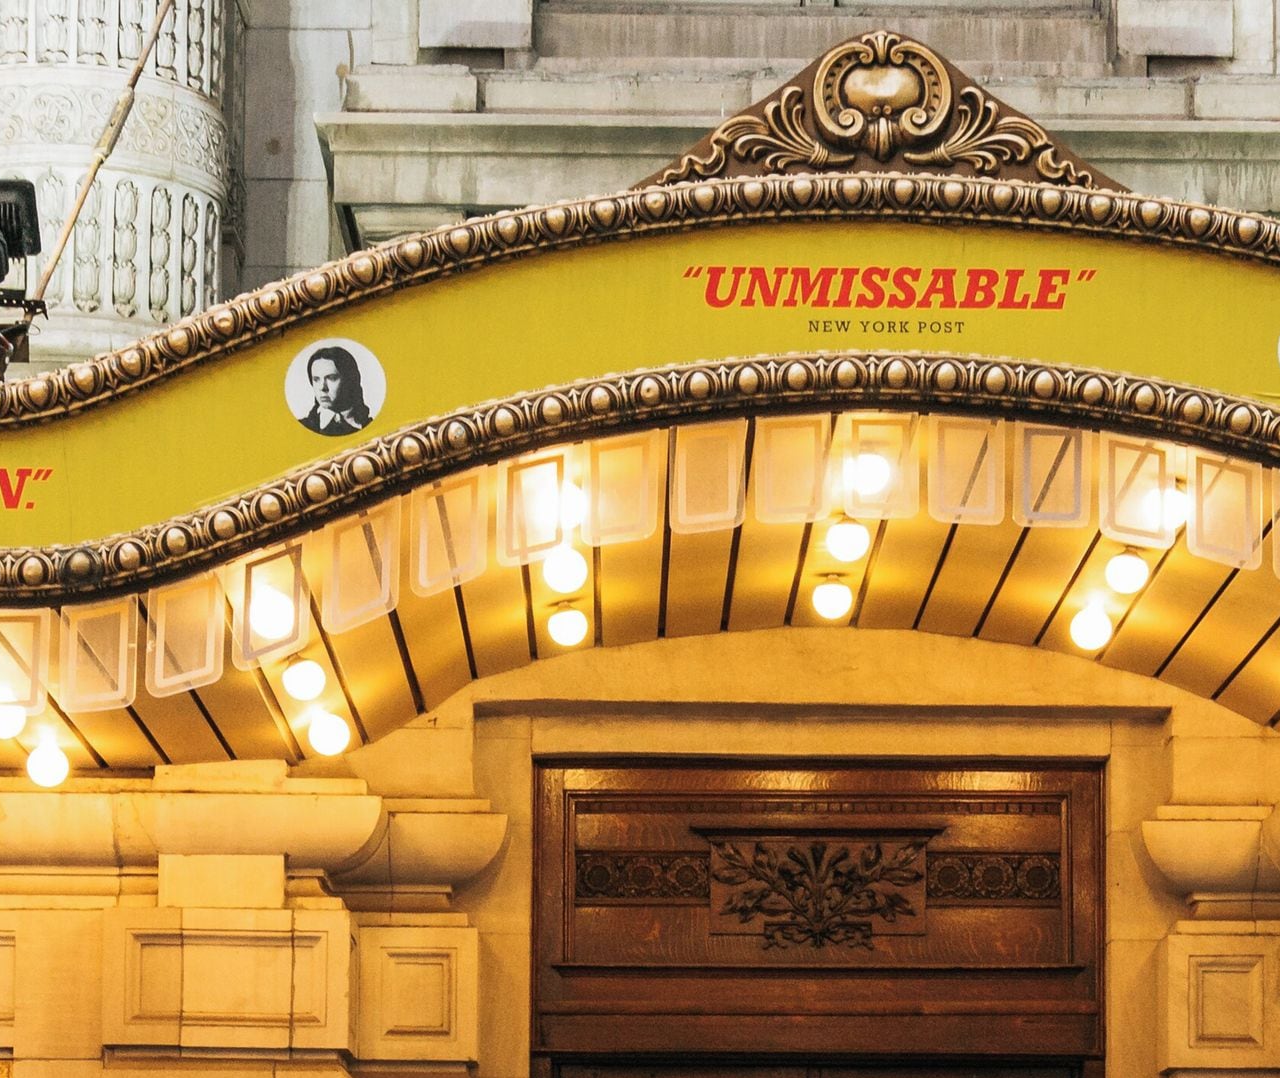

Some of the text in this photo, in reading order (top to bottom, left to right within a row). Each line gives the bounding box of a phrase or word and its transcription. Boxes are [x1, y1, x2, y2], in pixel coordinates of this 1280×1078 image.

[682, 266, 1097, 309] “UNMISSABLE”
[808, 320, 965, 334] NEW YORK POST
